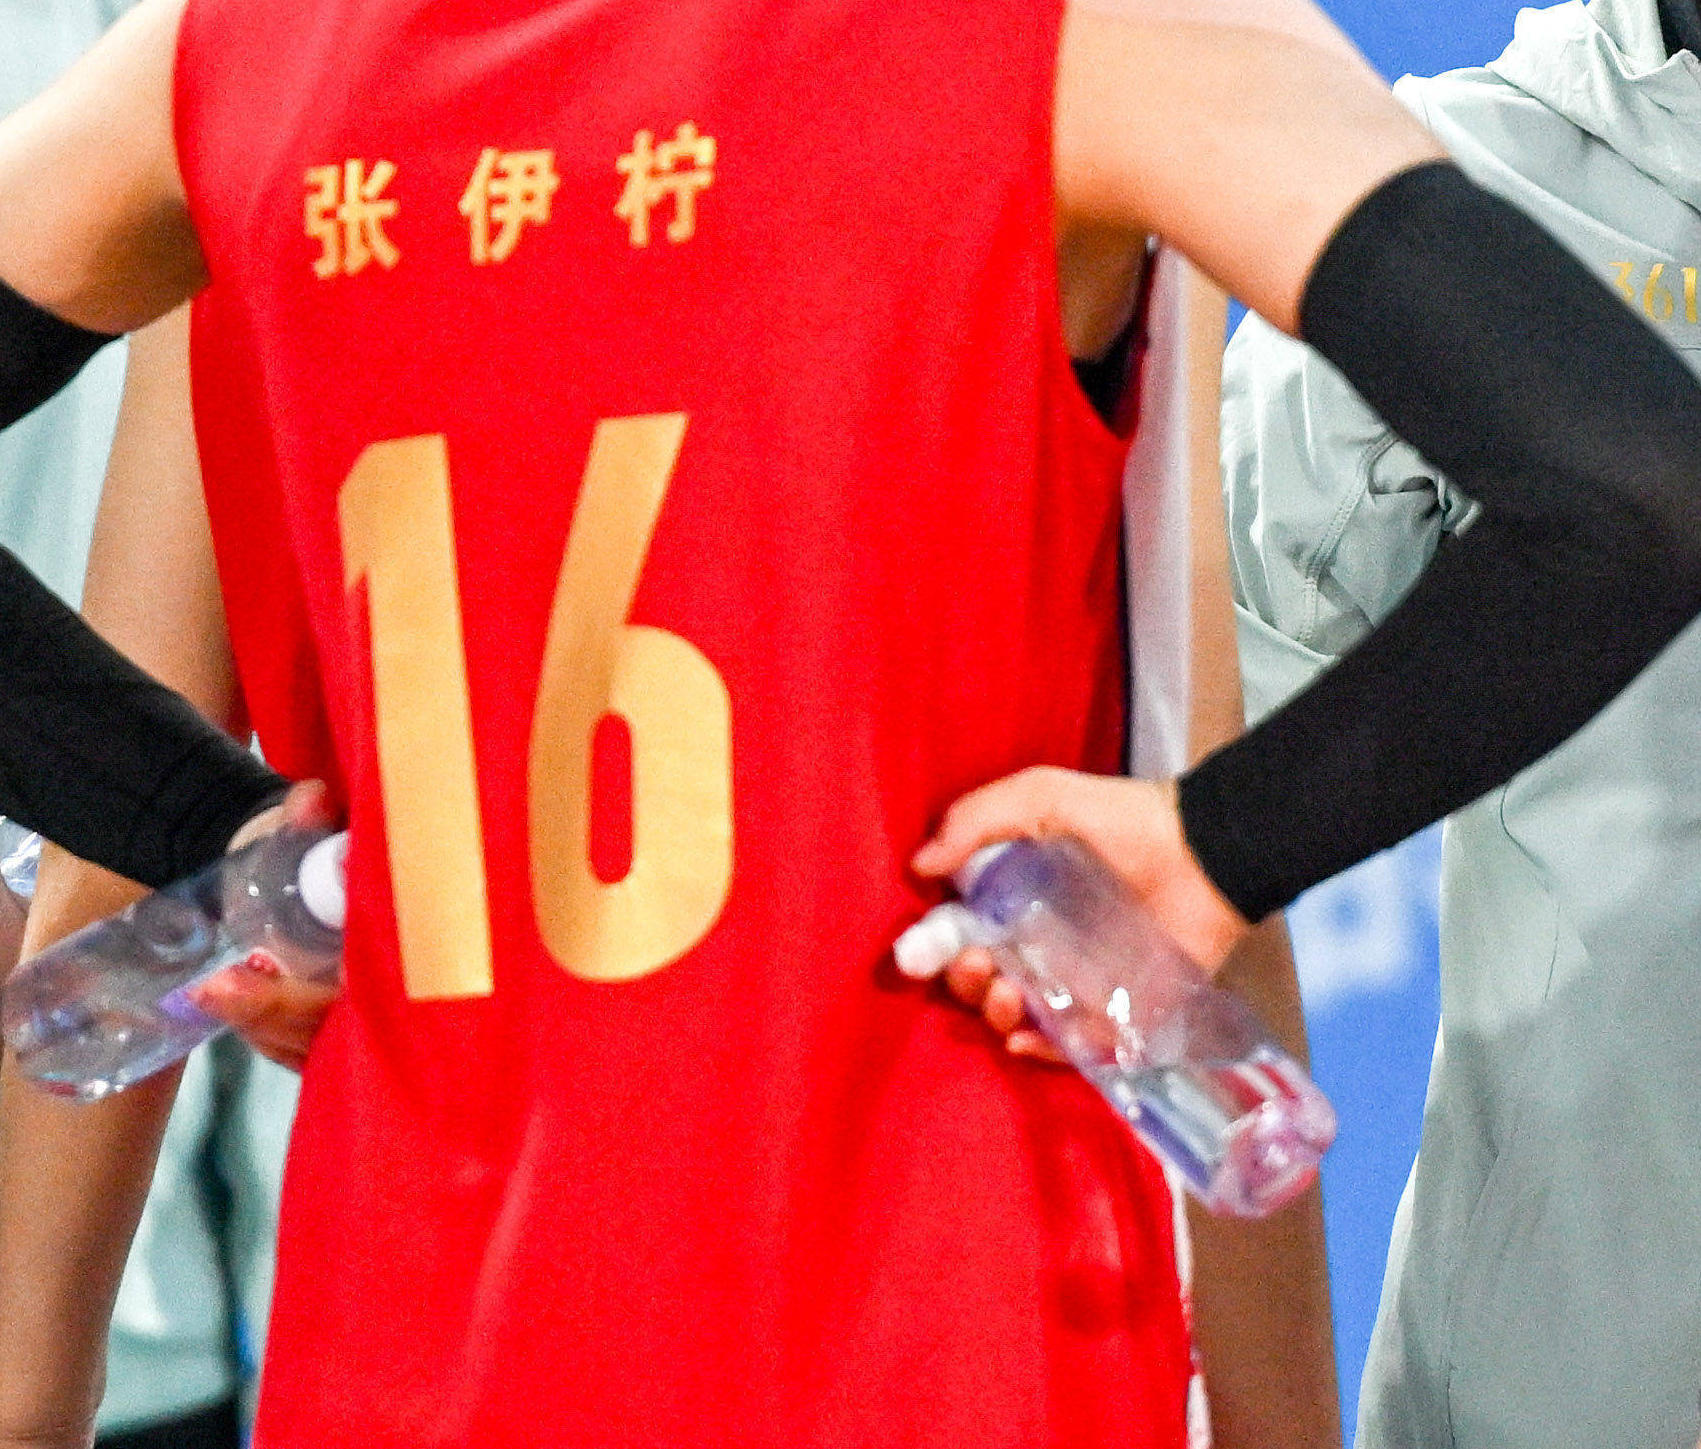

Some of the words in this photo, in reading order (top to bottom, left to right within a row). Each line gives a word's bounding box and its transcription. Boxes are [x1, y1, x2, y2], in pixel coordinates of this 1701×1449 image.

[303, 119, 718, 279] 张伊柠
[337, 410, 736, 1003] 16
